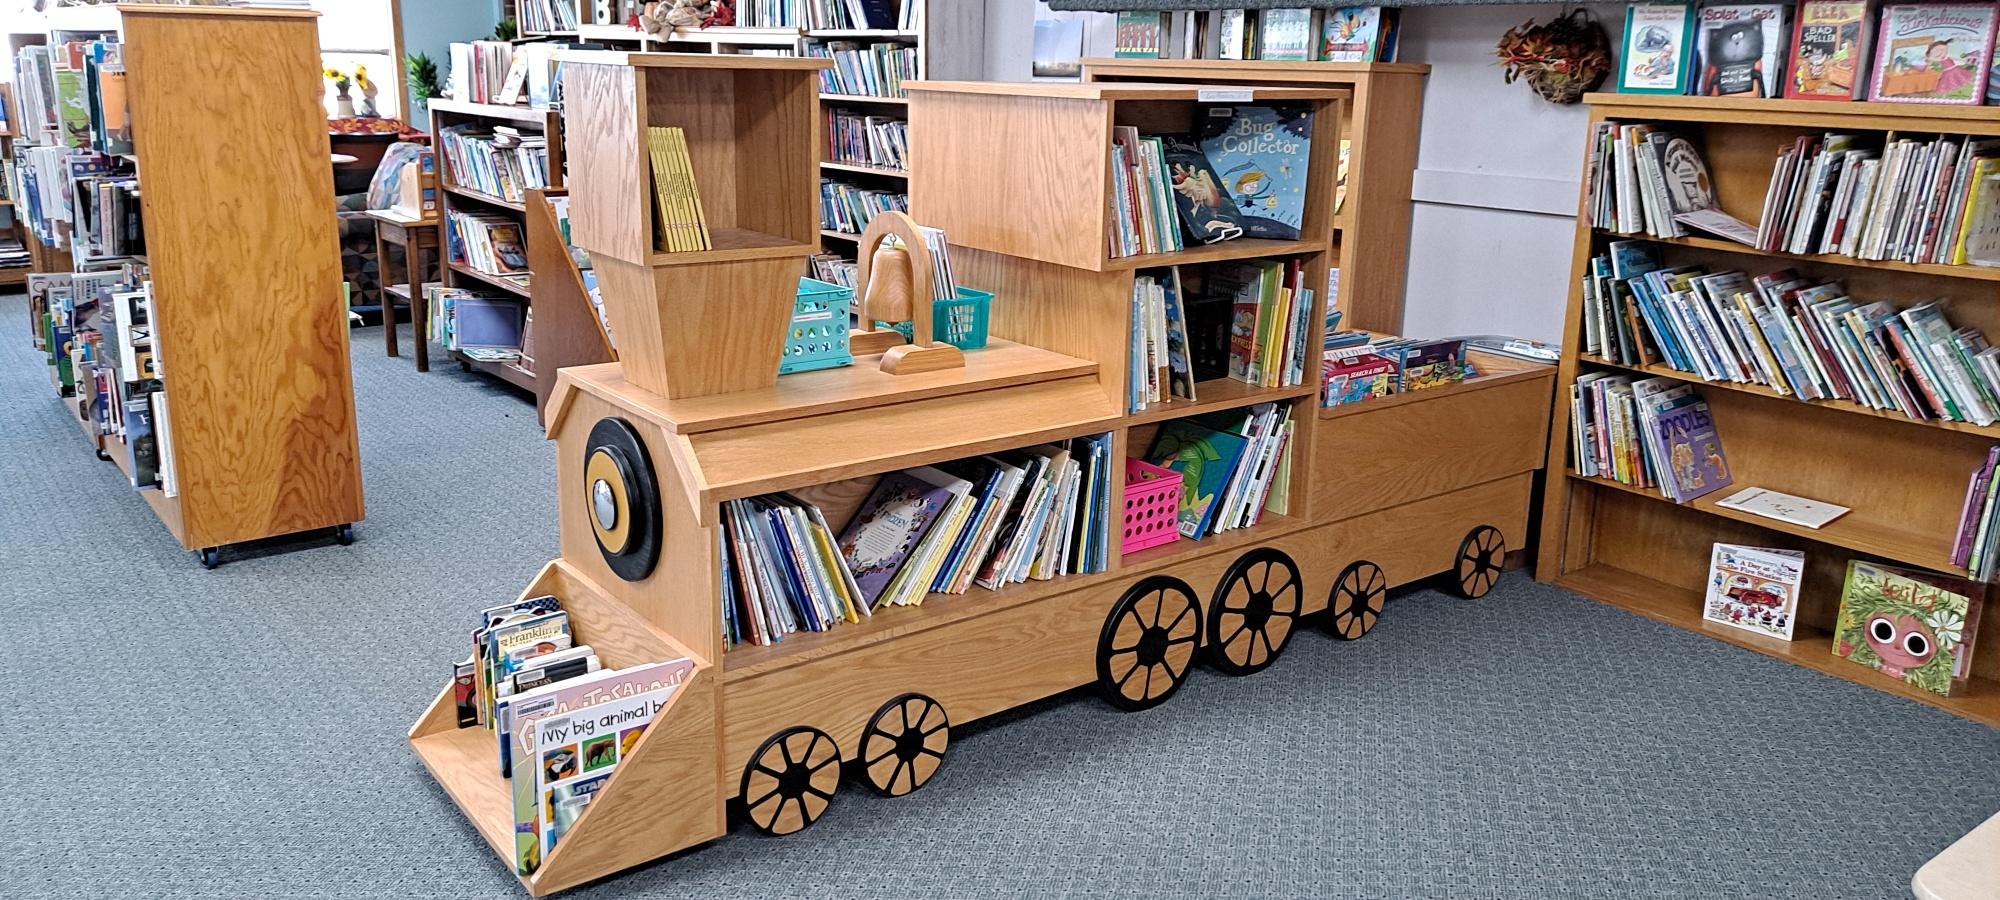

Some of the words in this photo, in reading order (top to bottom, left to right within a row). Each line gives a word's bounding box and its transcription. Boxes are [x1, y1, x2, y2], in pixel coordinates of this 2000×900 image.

[1704, 8, 1740, 21] Splat
[1751, 8, 1776, 20] Cat
[1803, 32, 1836, 43] SPELLER
[1809, 26, 1833, 35] BAD
[1236, 117, 1275, 141] Bug
[1221, 135, 1300, 156] Collector
[1660, 410, 1710, 440] ZOODLES
[509, 626, 553, 644] Franklin
[542, 727, 569, 744] My
[573, 719, 595, 736] big
[599, 700, 648, 726] animal
